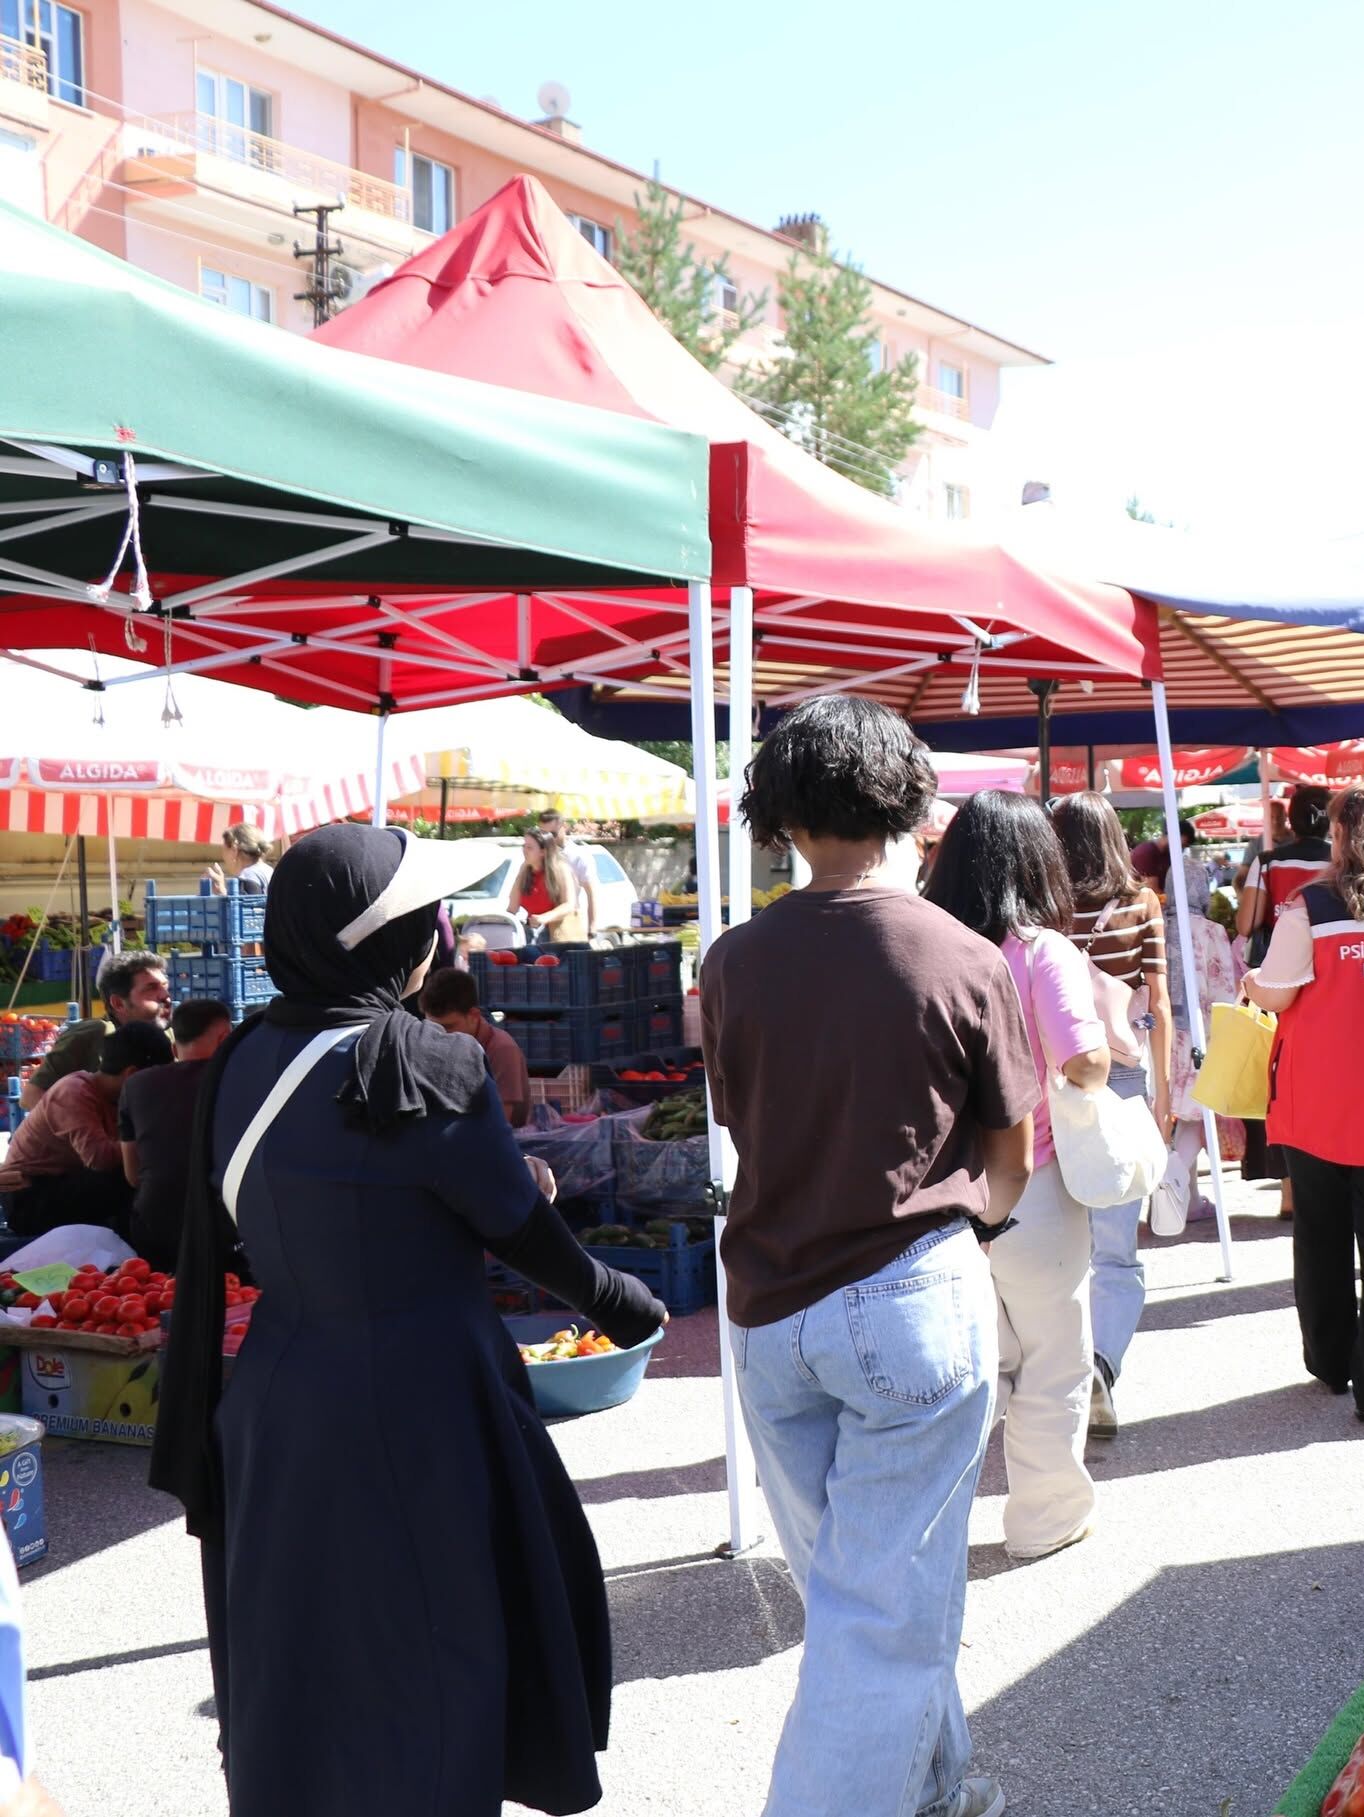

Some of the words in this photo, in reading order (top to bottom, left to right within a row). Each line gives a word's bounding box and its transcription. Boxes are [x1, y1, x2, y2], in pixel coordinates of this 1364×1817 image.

[59, 762, 140, 780] ALGIDA
[36, 1355, 65, 1374] Dole
[92, 1420, 155, 1439] BANANAS
